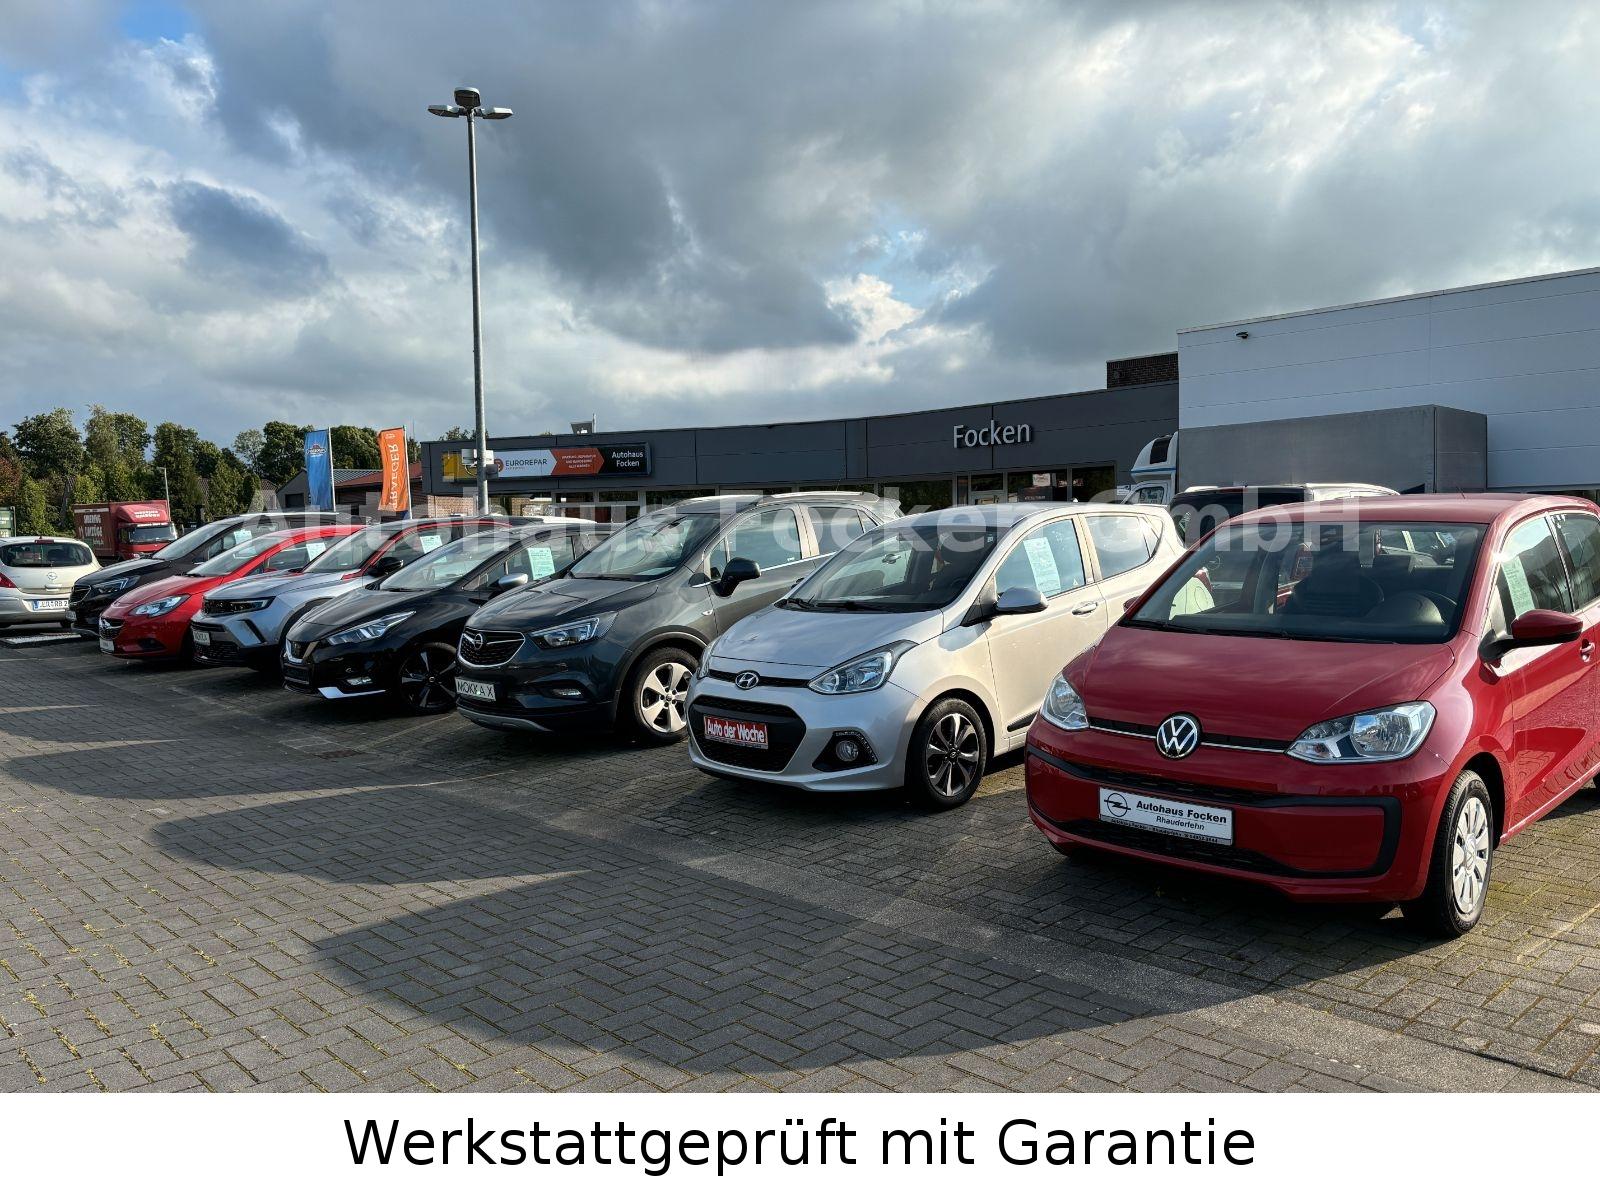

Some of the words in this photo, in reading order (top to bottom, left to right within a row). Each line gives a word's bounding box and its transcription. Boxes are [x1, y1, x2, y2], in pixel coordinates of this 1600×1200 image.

[953, 419, 1030, 449] Focken
[505, 458, 548, 467] EUROREPAR
[611, 450, 644, 460] Autohaus
[616, 459, 640, 468] Focken
[707, 718, 723, 737] Auto
[723, 721, 736, 738] der
[736, 723, 764, 743] Woche
[1136, 800, 1184, 817] Autohaus
[1187, 809, 1227, 824] Focken
[1155, 815, 1205, 831] Rhauderfehn
